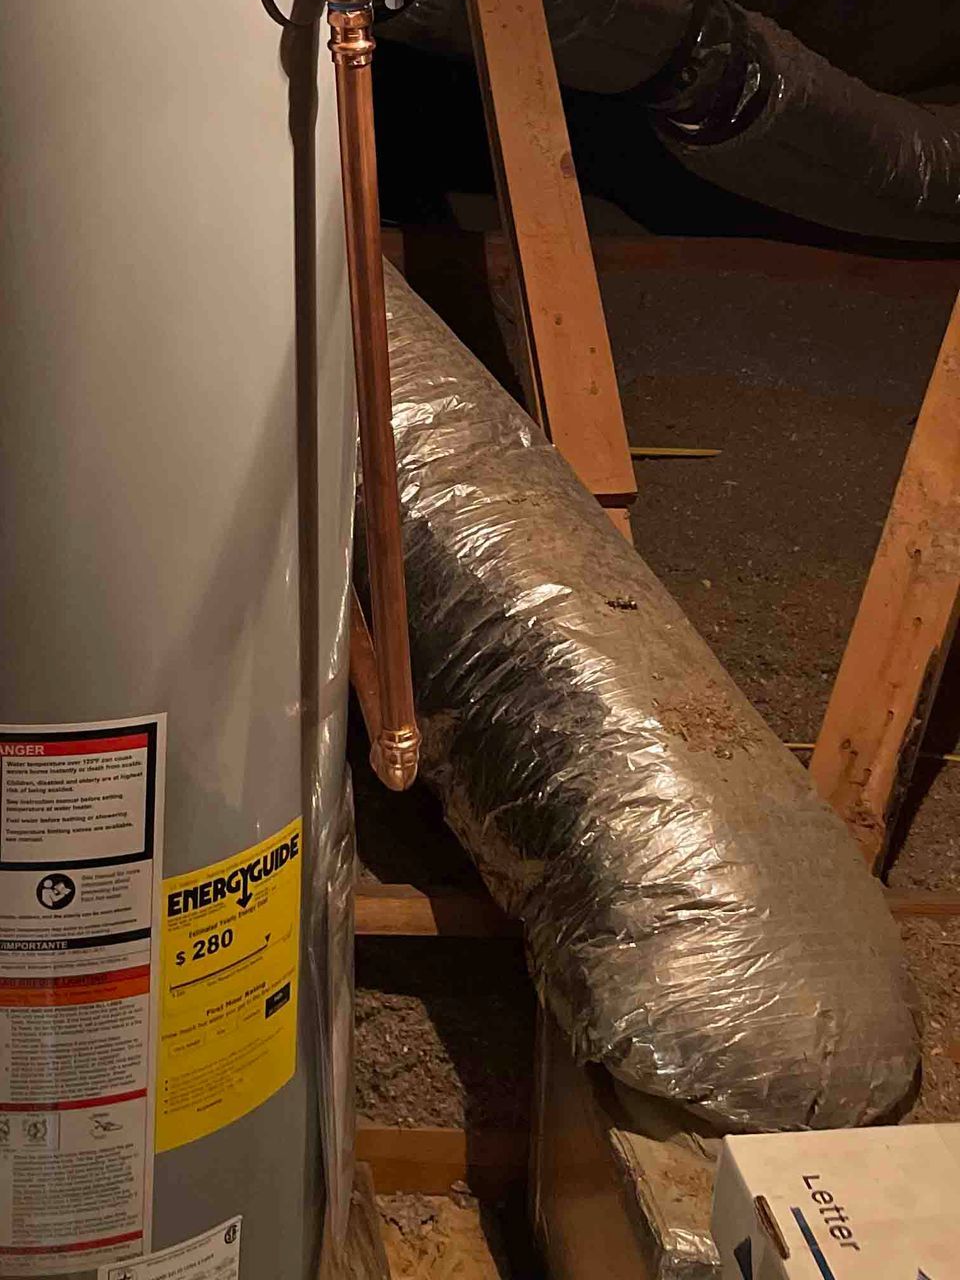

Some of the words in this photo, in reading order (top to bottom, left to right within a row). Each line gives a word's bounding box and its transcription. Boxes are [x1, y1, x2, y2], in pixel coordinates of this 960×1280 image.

[168, 832, 300, 918] ENERGYGUIDE
[176, 951, 186, 966] $
[192, 928, 234, 960] 280
[206, 1004, 224, 1016] First
[244, 981, 267, 998] Rating
[802, 1174, 861, 1252] Letter
